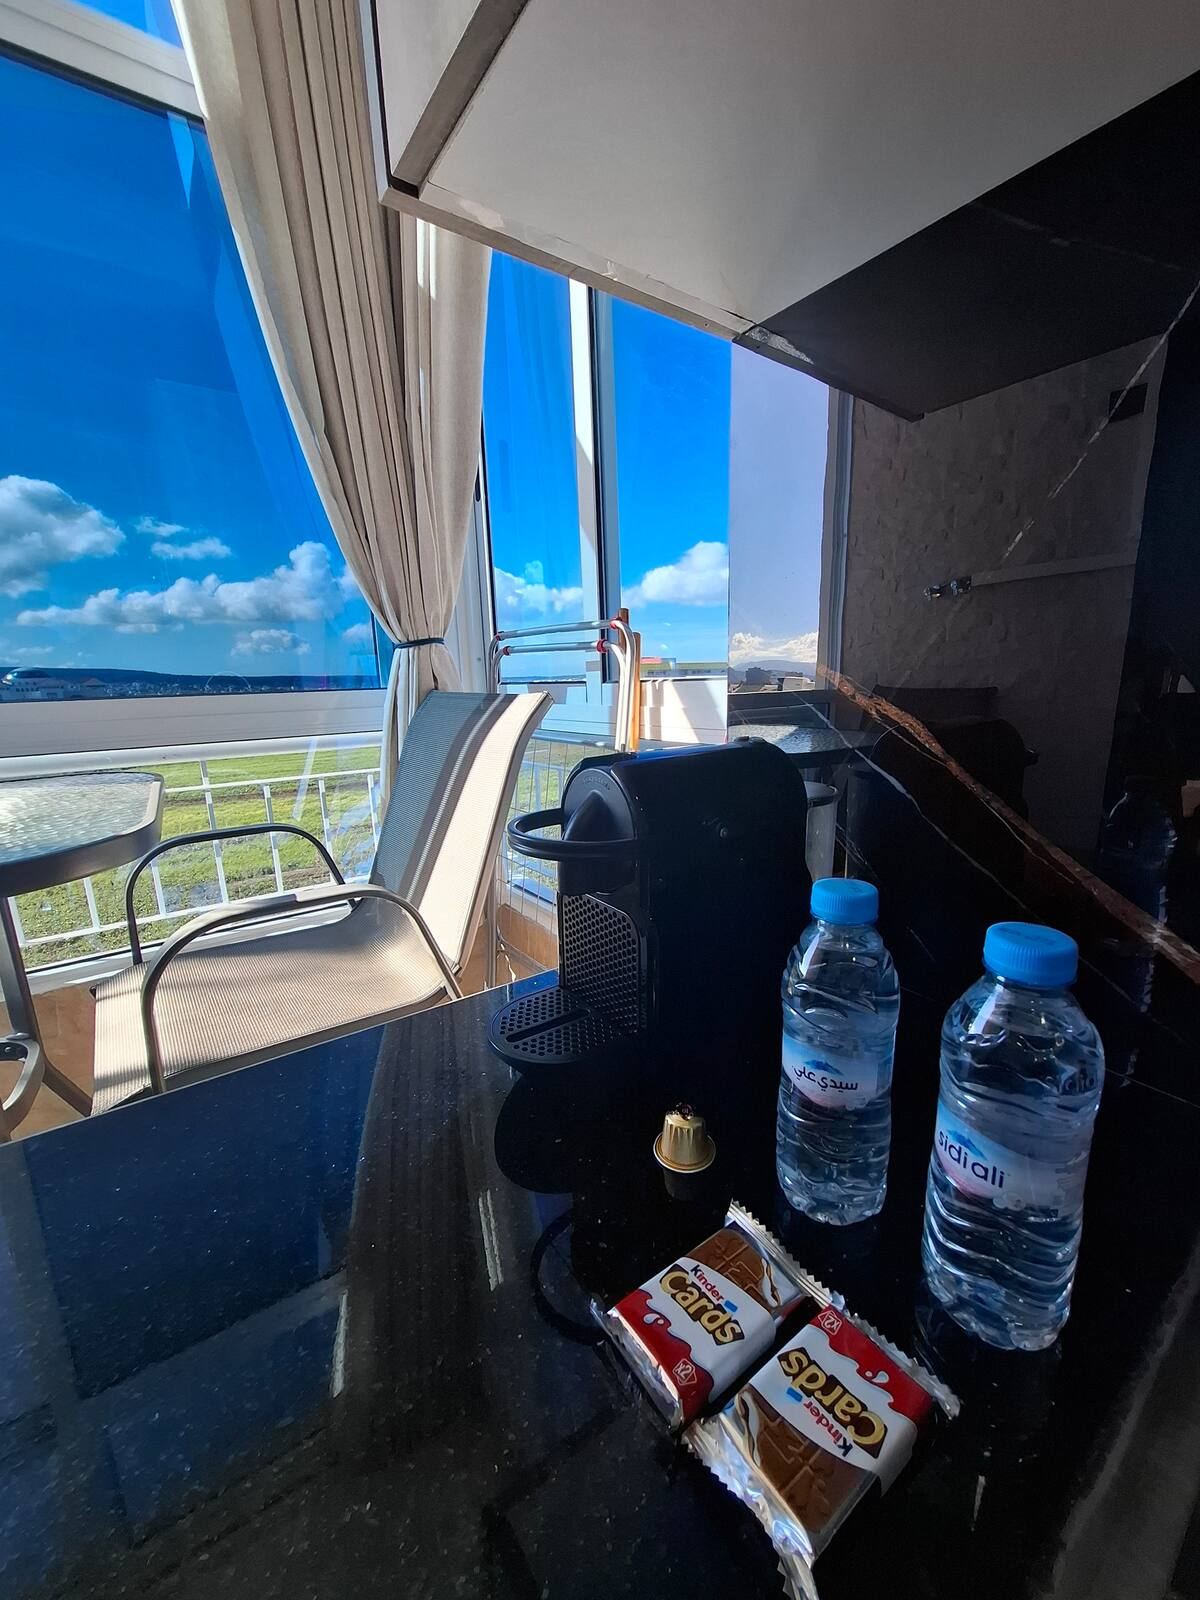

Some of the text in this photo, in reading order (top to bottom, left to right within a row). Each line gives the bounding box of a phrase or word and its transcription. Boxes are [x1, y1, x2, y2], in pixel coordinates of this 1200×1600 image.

[793, 1066, 859, 1092] سيدي علي
[938, 1130, 1005, 1189] sidi ali
[660, 1267, 743, 1344] Cards
[779, 1349, 886, 1448] Cards
